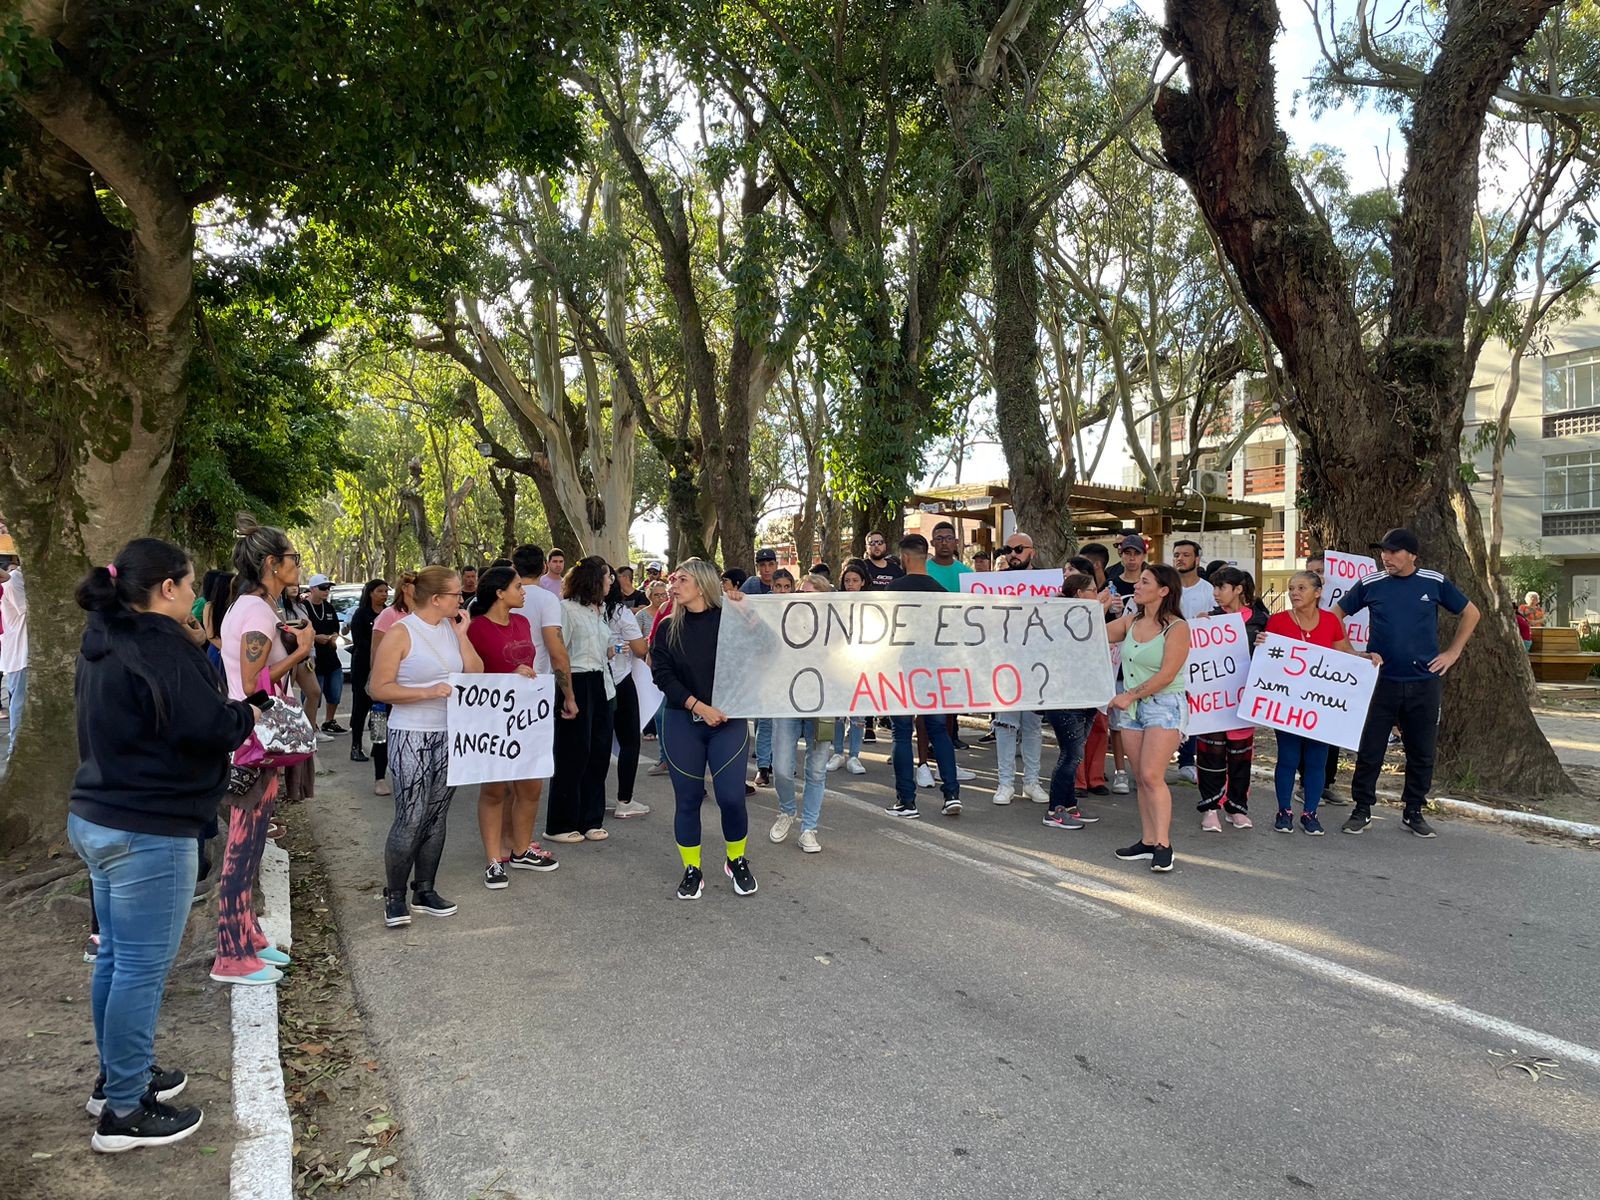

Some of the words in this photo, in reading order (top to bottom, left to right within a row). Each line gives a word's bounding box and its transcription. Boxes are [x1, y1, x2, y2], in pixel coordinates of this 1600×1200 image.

[781, 601, 922, 649] ONDE
[1063, 605, 1093, 642] O
[1189, 623, 1237, 649] IDOS
[1189, 656, 1236, 684] PELO
[1309, 655, 1358, 685] dias
[454, 684, 515, 712] TODOS
[789, 667, 824, 713] O
[1186, 686, 1246, 714] NGEL
[1253, 678, 1289, 696] sem
[1300, 690, 1347, 712] meu
[506, 699, 550, 736] PELO
[1251, 696, 1318, 730] FILHO
[453, 732, 521, 759] ANGELO
